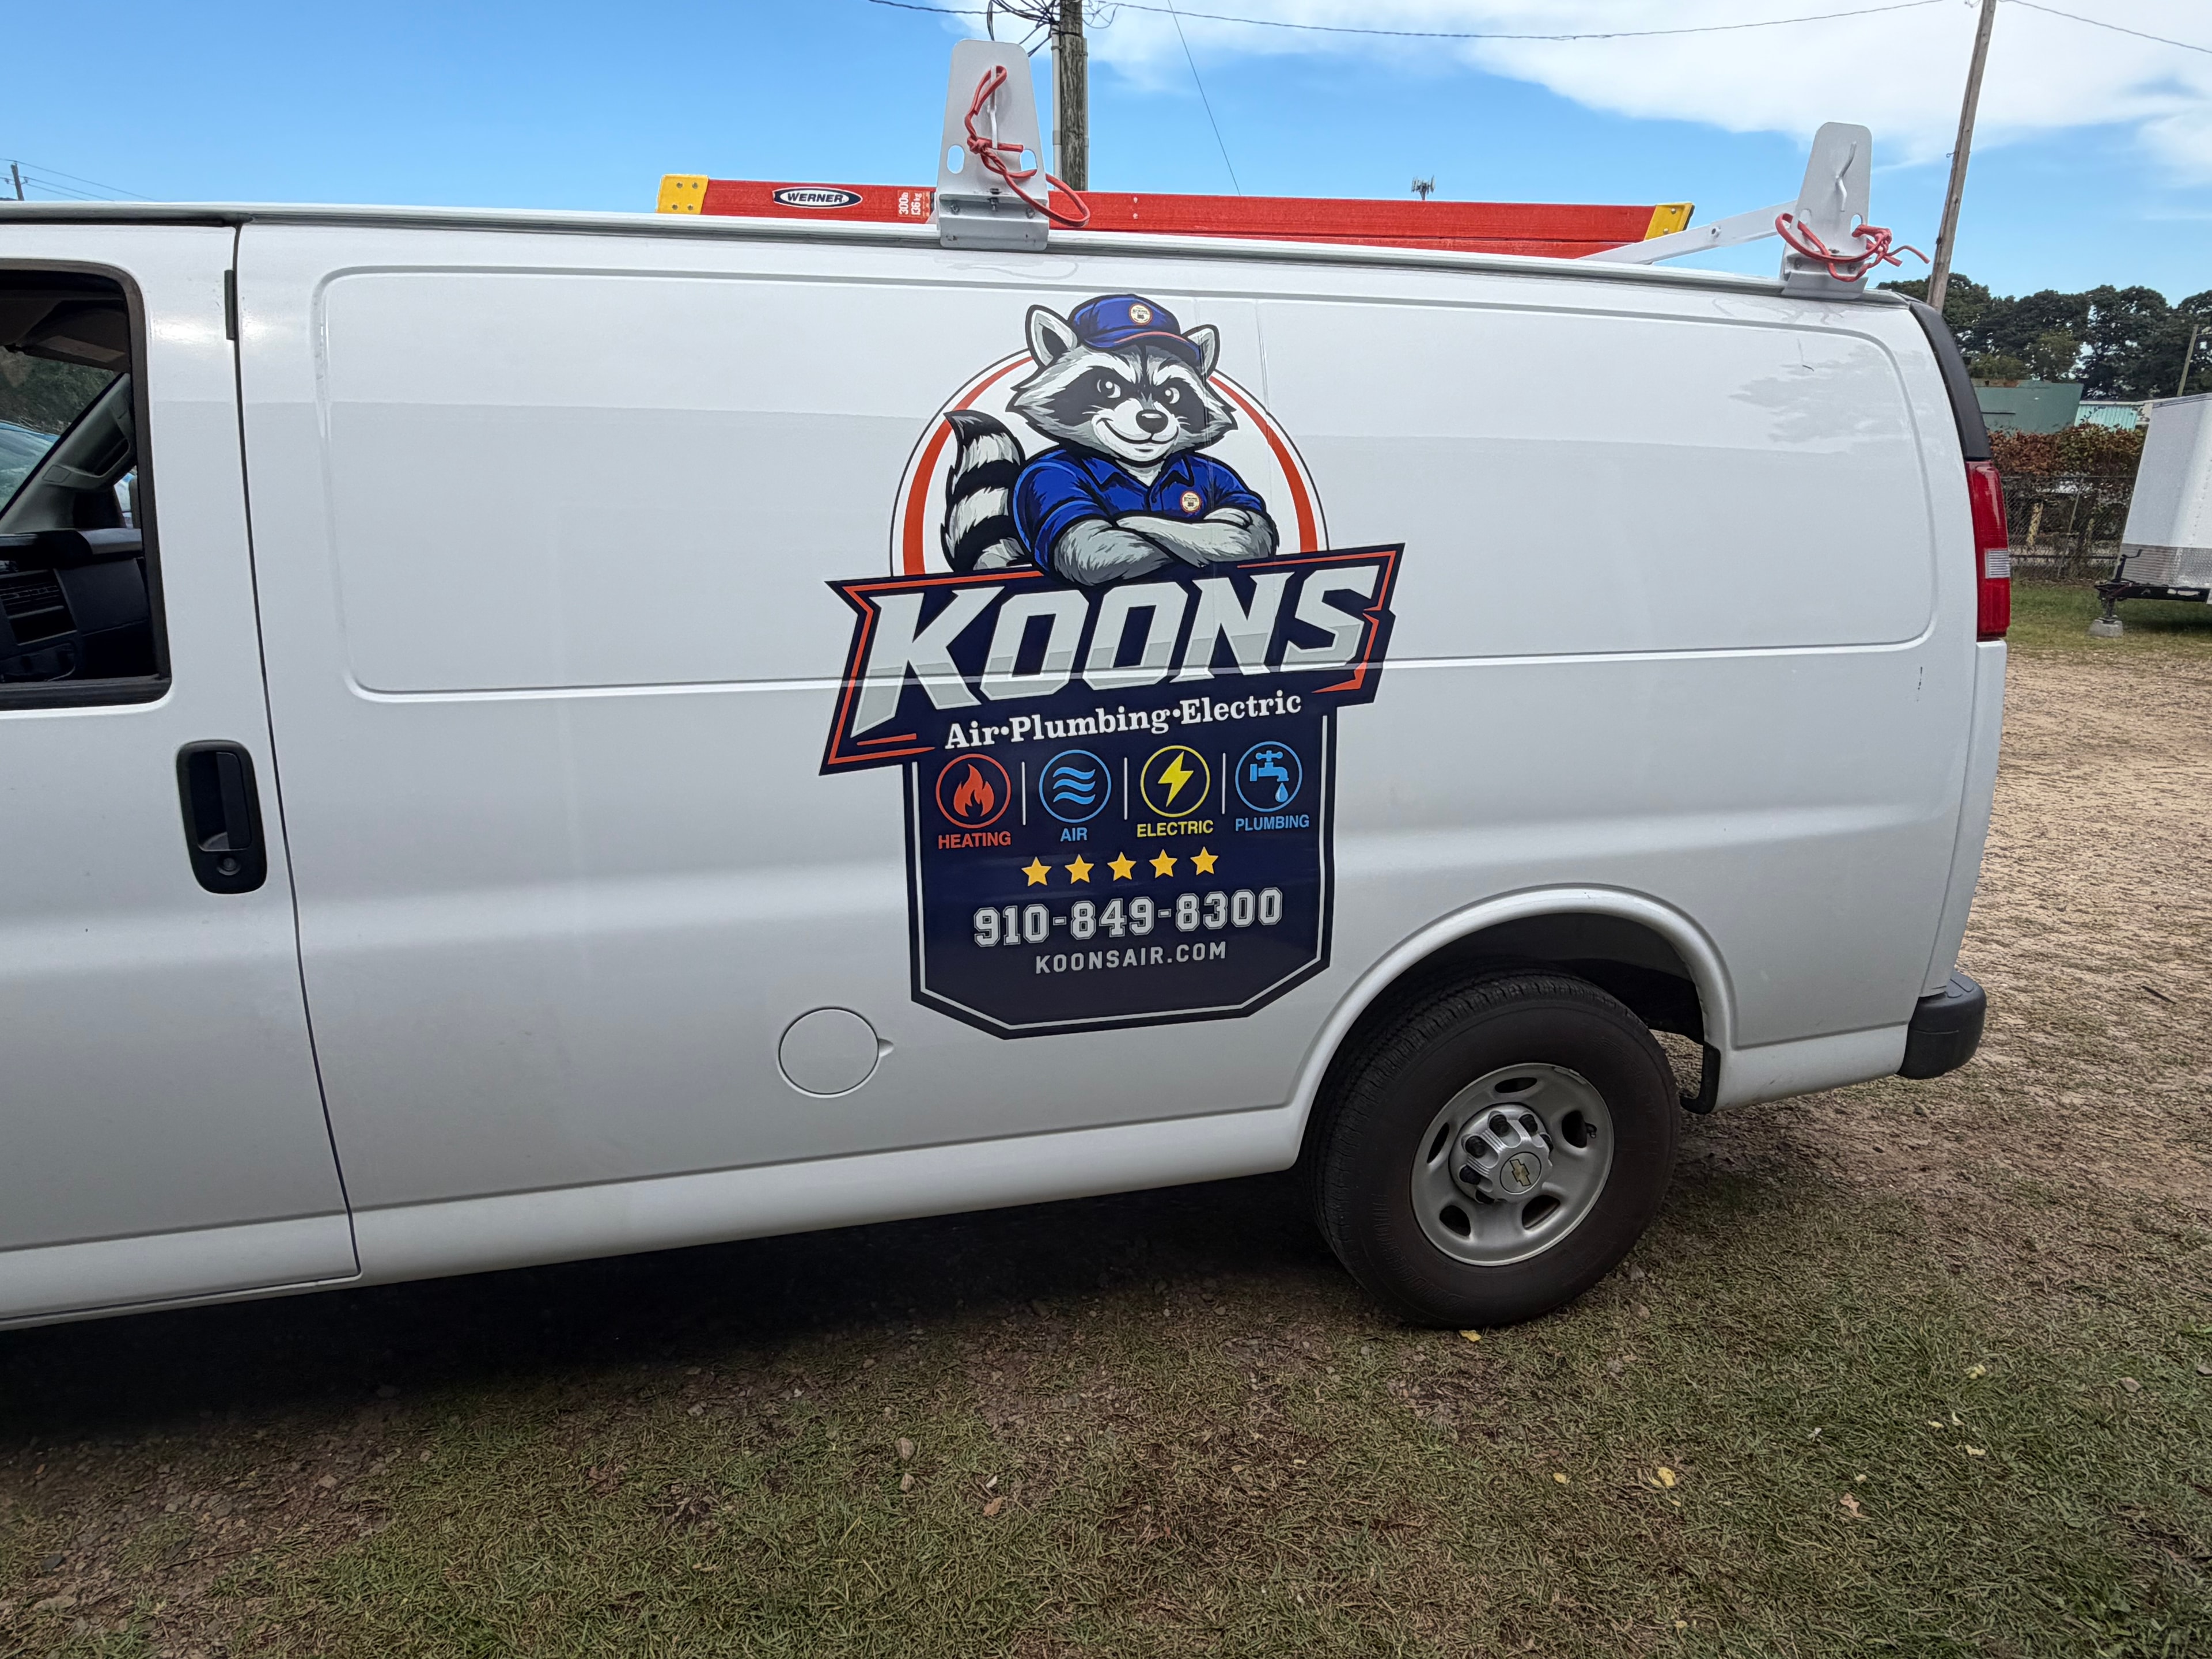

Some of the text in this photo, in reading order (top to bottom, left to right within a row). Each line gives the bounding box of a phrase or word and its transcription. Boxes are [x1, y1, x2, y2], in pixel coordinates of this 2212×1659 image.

[787, 192, 844, 203] WERNER
[850, 565, 1380, 738] KOONS
[1137, 820, 1214, 838] ELECTRIC
[1235, 814, 1310, 832] PLUMBING
[938, 831, 1012, 850] HEATING
[1059, 827, 1088, 843] AIR
[974, 887, 1284, 948] 910-849-8300
[1035, 941, 1227, 975] KOONSAIR.COM
